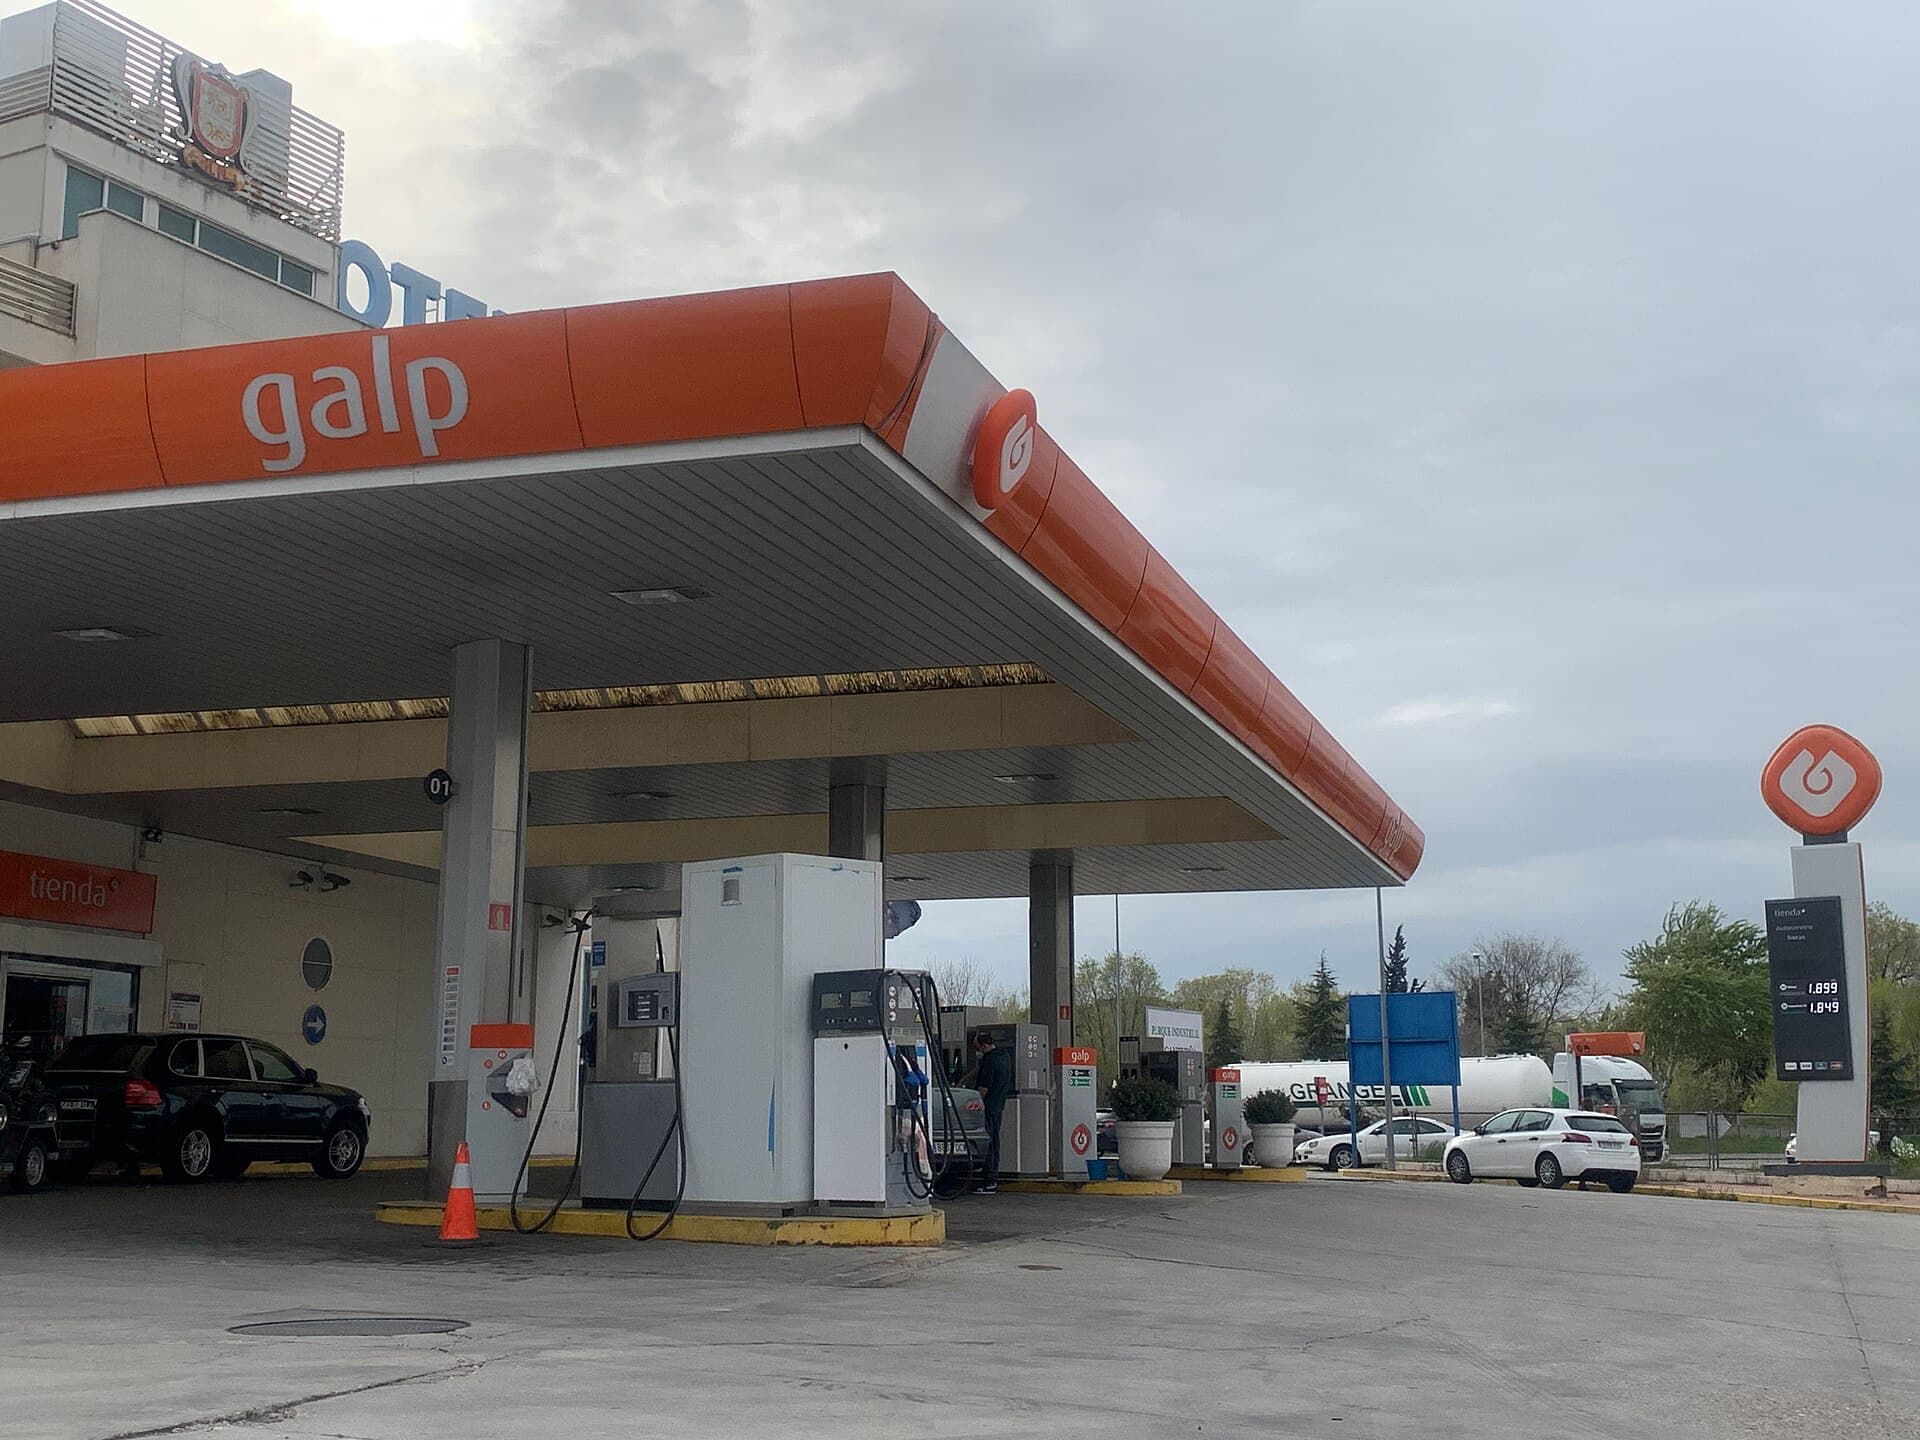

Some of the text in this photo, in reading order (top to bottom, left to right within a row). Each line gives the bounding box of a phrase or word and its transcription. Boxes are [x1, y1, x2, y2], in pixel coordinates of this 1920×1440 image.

[241, 335, 470, 472] galp
[431, 777, 449, 796] 01
[30, 869, 106, 907] tienda
[1808, 982, 1838, 994] 1.899
[1810, 1001, 1839, 1014] 1.849
[1071, 1049, 1090, 1063] galp
